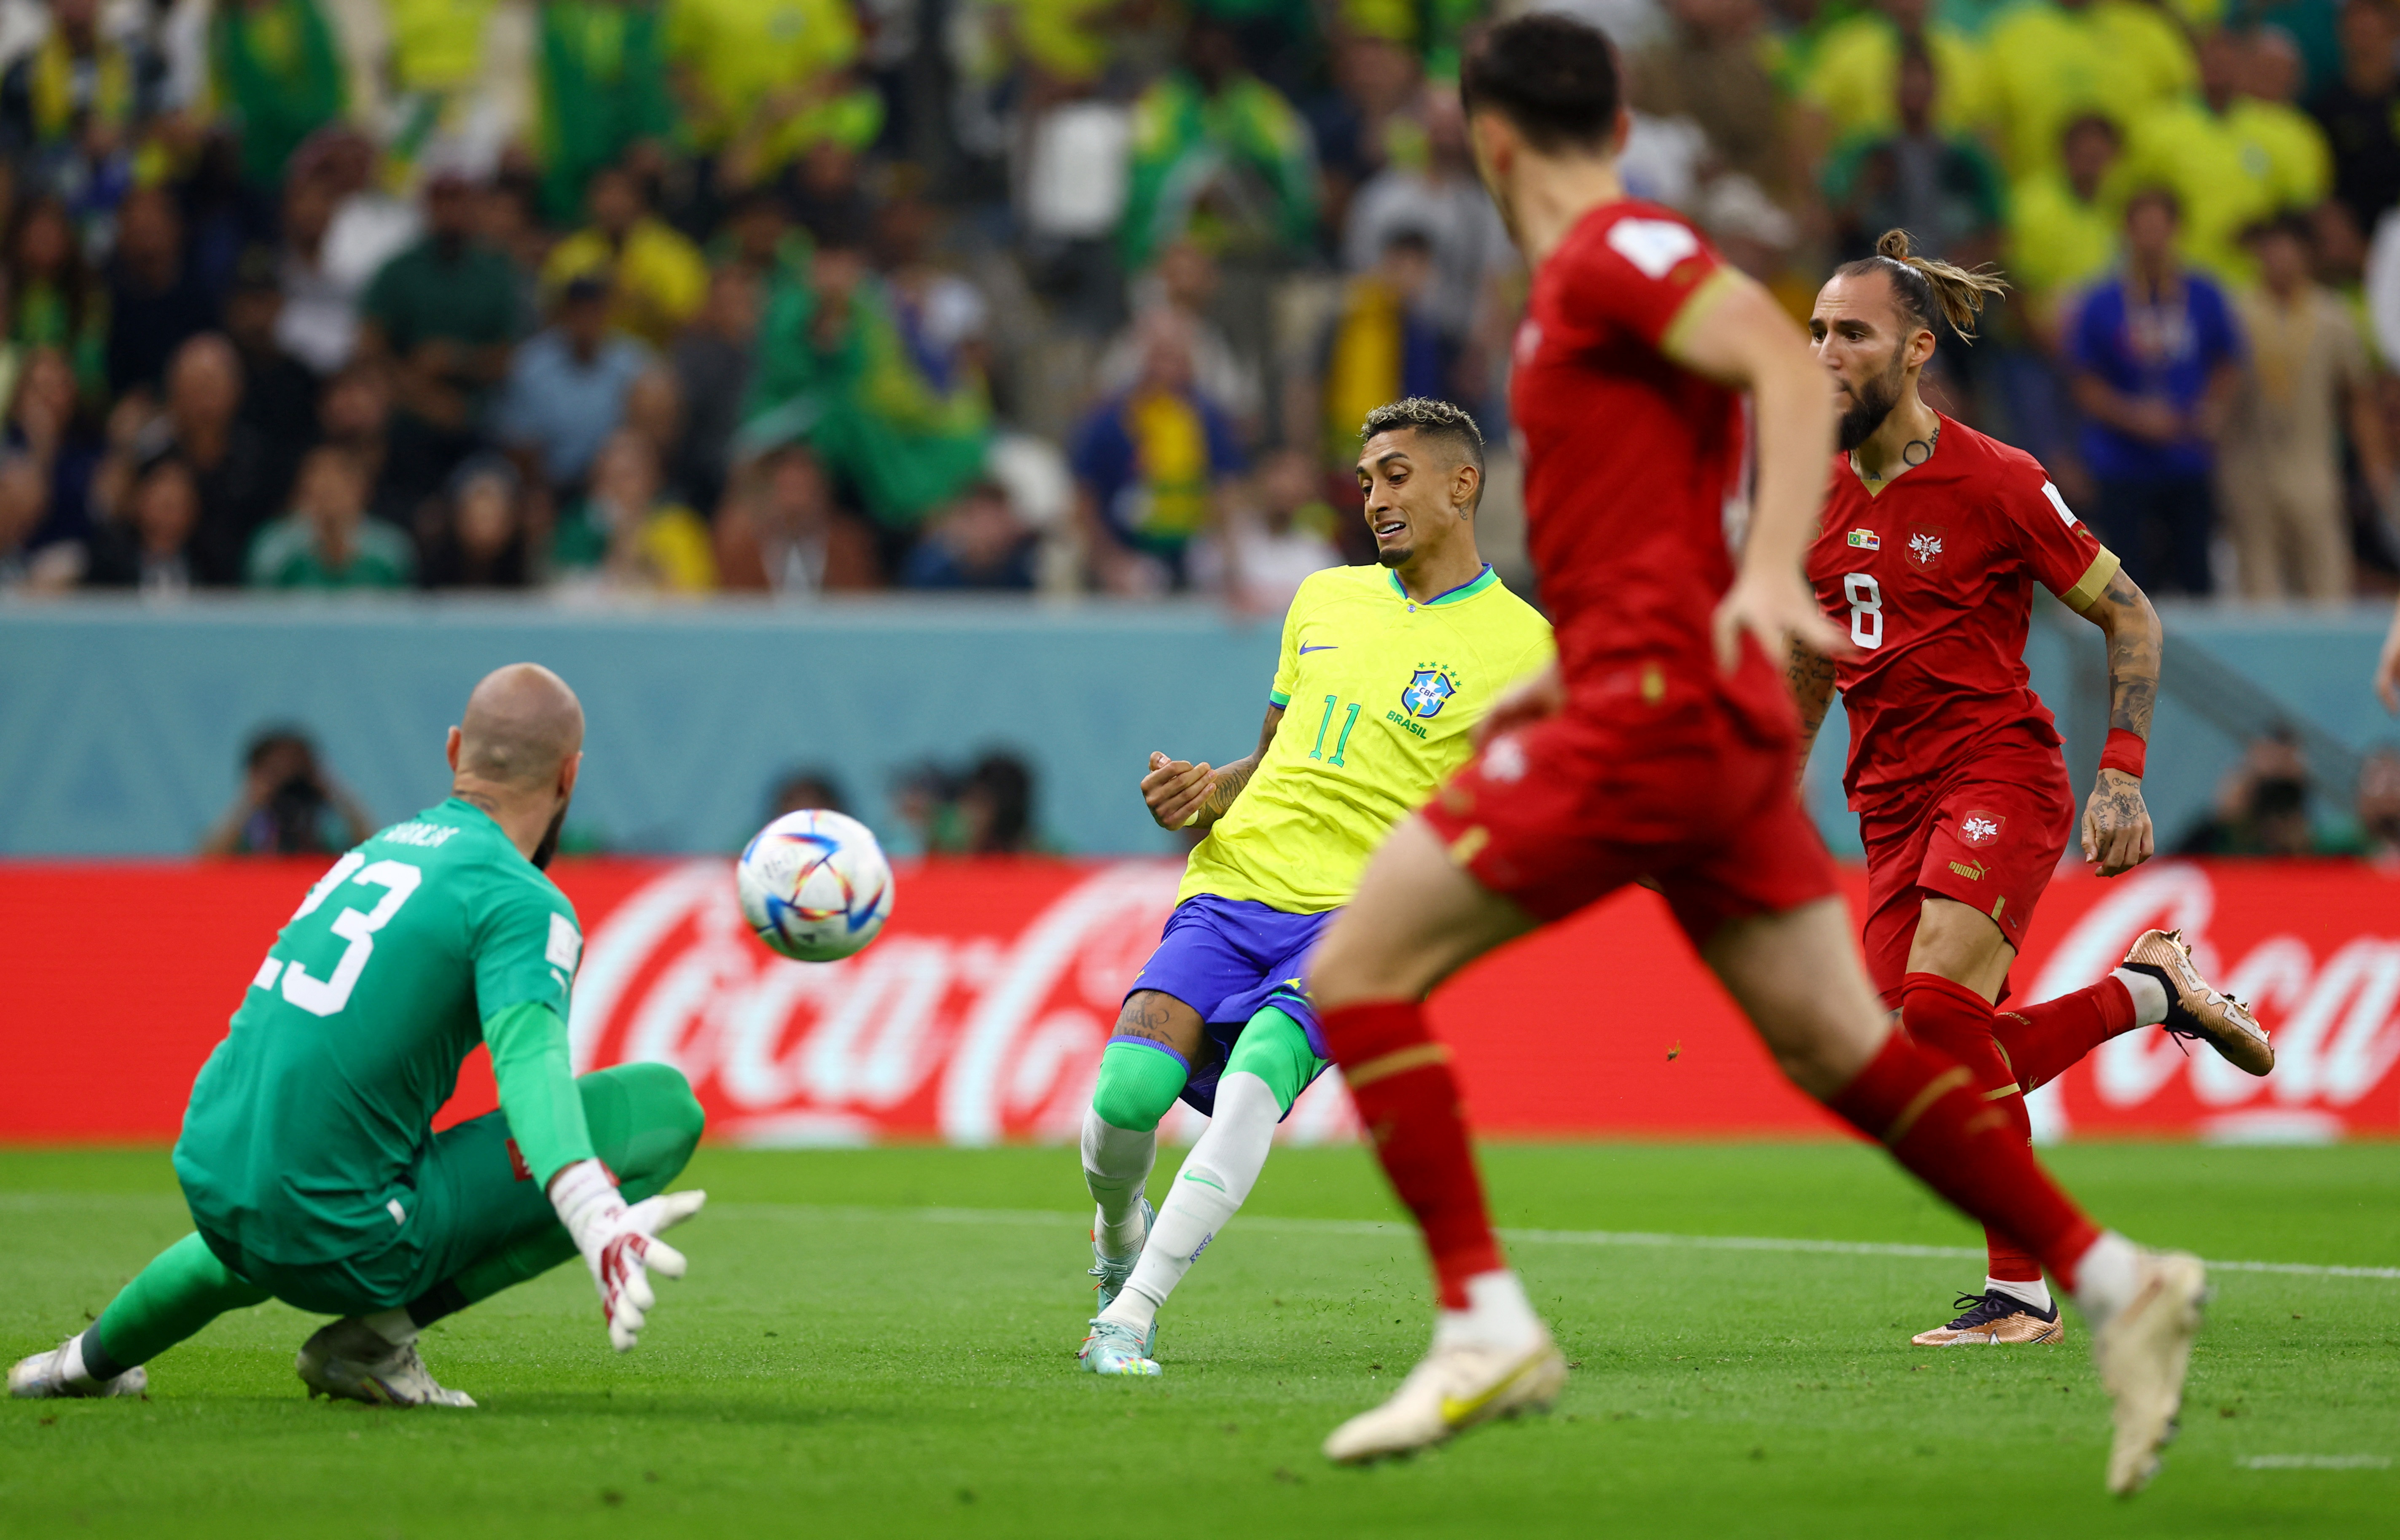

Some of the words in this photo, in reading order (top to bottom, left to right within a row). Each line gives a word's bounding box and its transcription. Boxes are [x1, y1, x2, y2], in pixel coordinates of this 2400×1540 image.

[1844, 572, 1883, 650] 8
[1419, 687, 1436, 698] CBF
[1309, 695, 1361, 768] 11
[1386, 710, 1427, 740] BRASIL
[1948, 860, 1981, 881] PUMA
